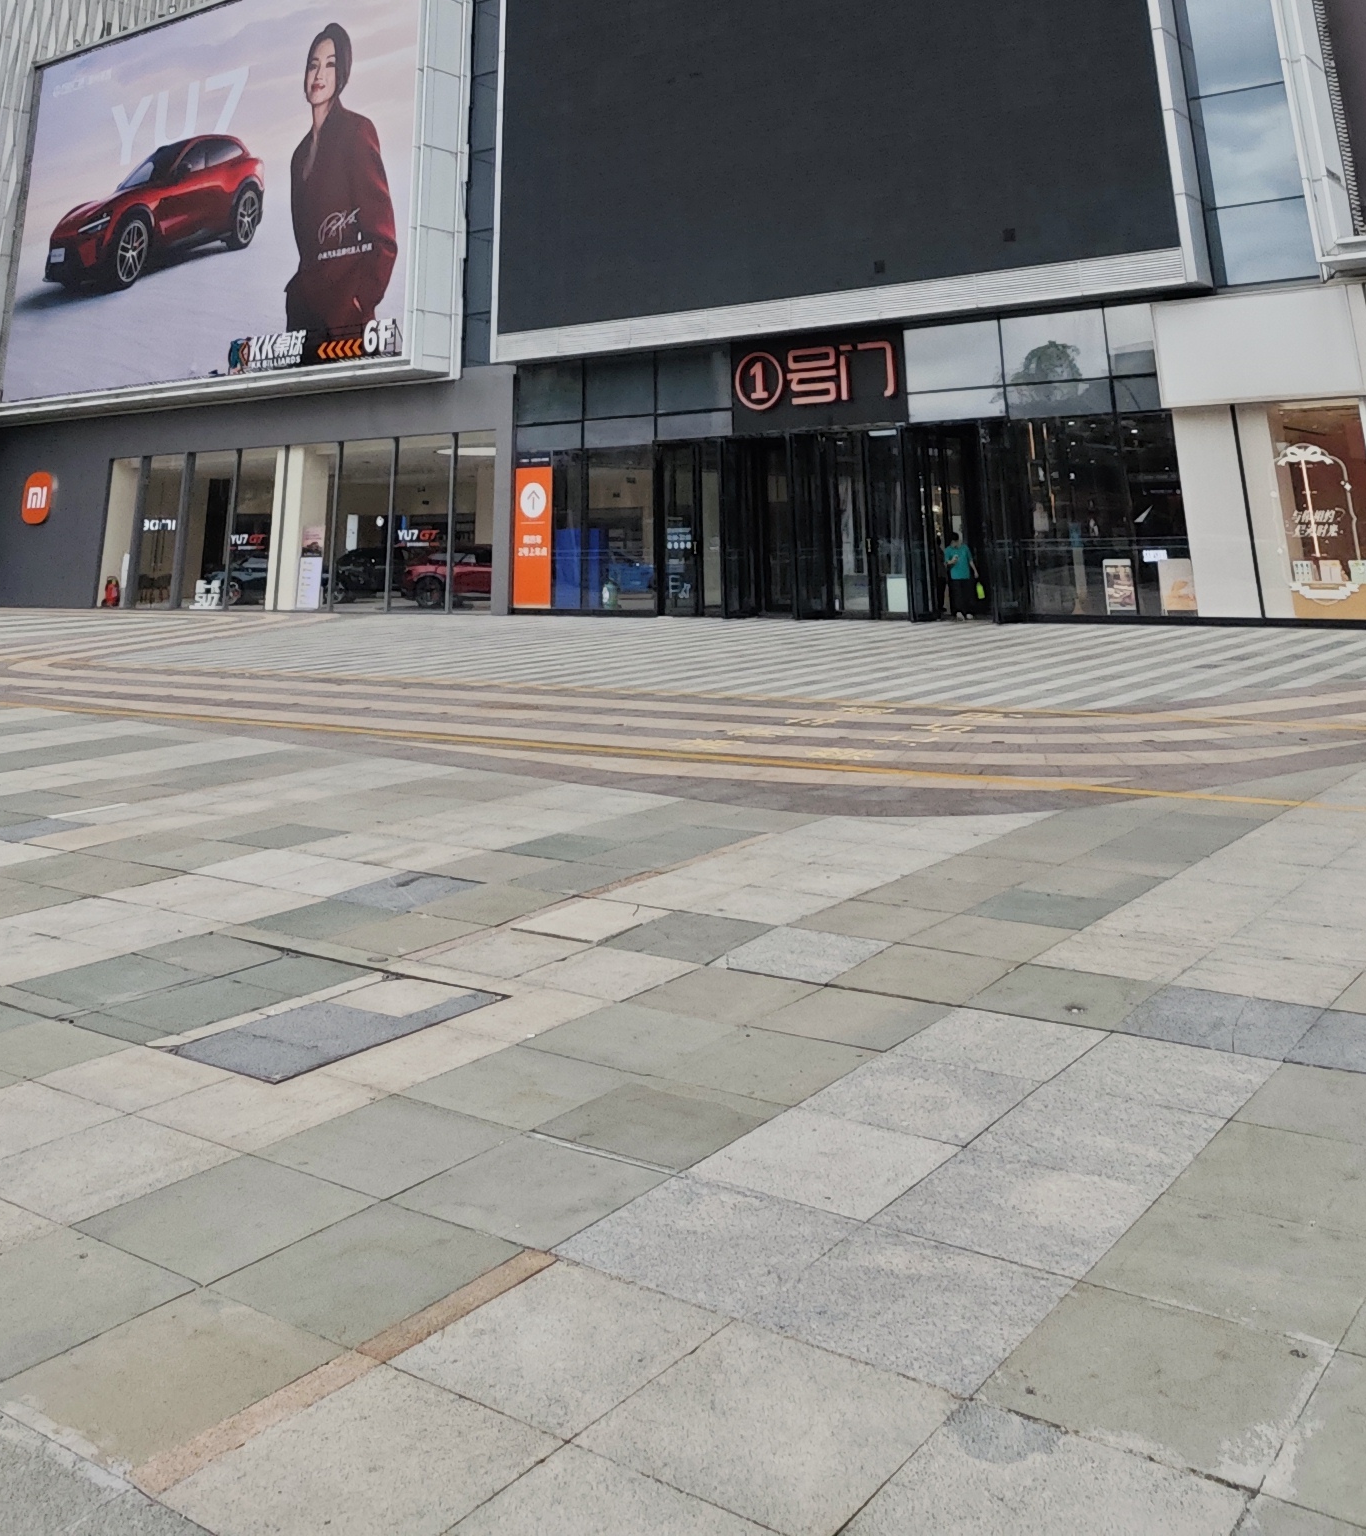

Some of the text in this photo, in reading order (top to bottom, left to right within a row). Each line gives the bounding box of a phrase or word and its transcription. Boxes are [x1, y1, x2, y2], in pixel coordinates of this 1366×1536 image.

[111, 66, 250, 166] YU7
[248, 319, 394, 362] KK桌球 6F
[398, 529, 441, 541] YU7 GT
